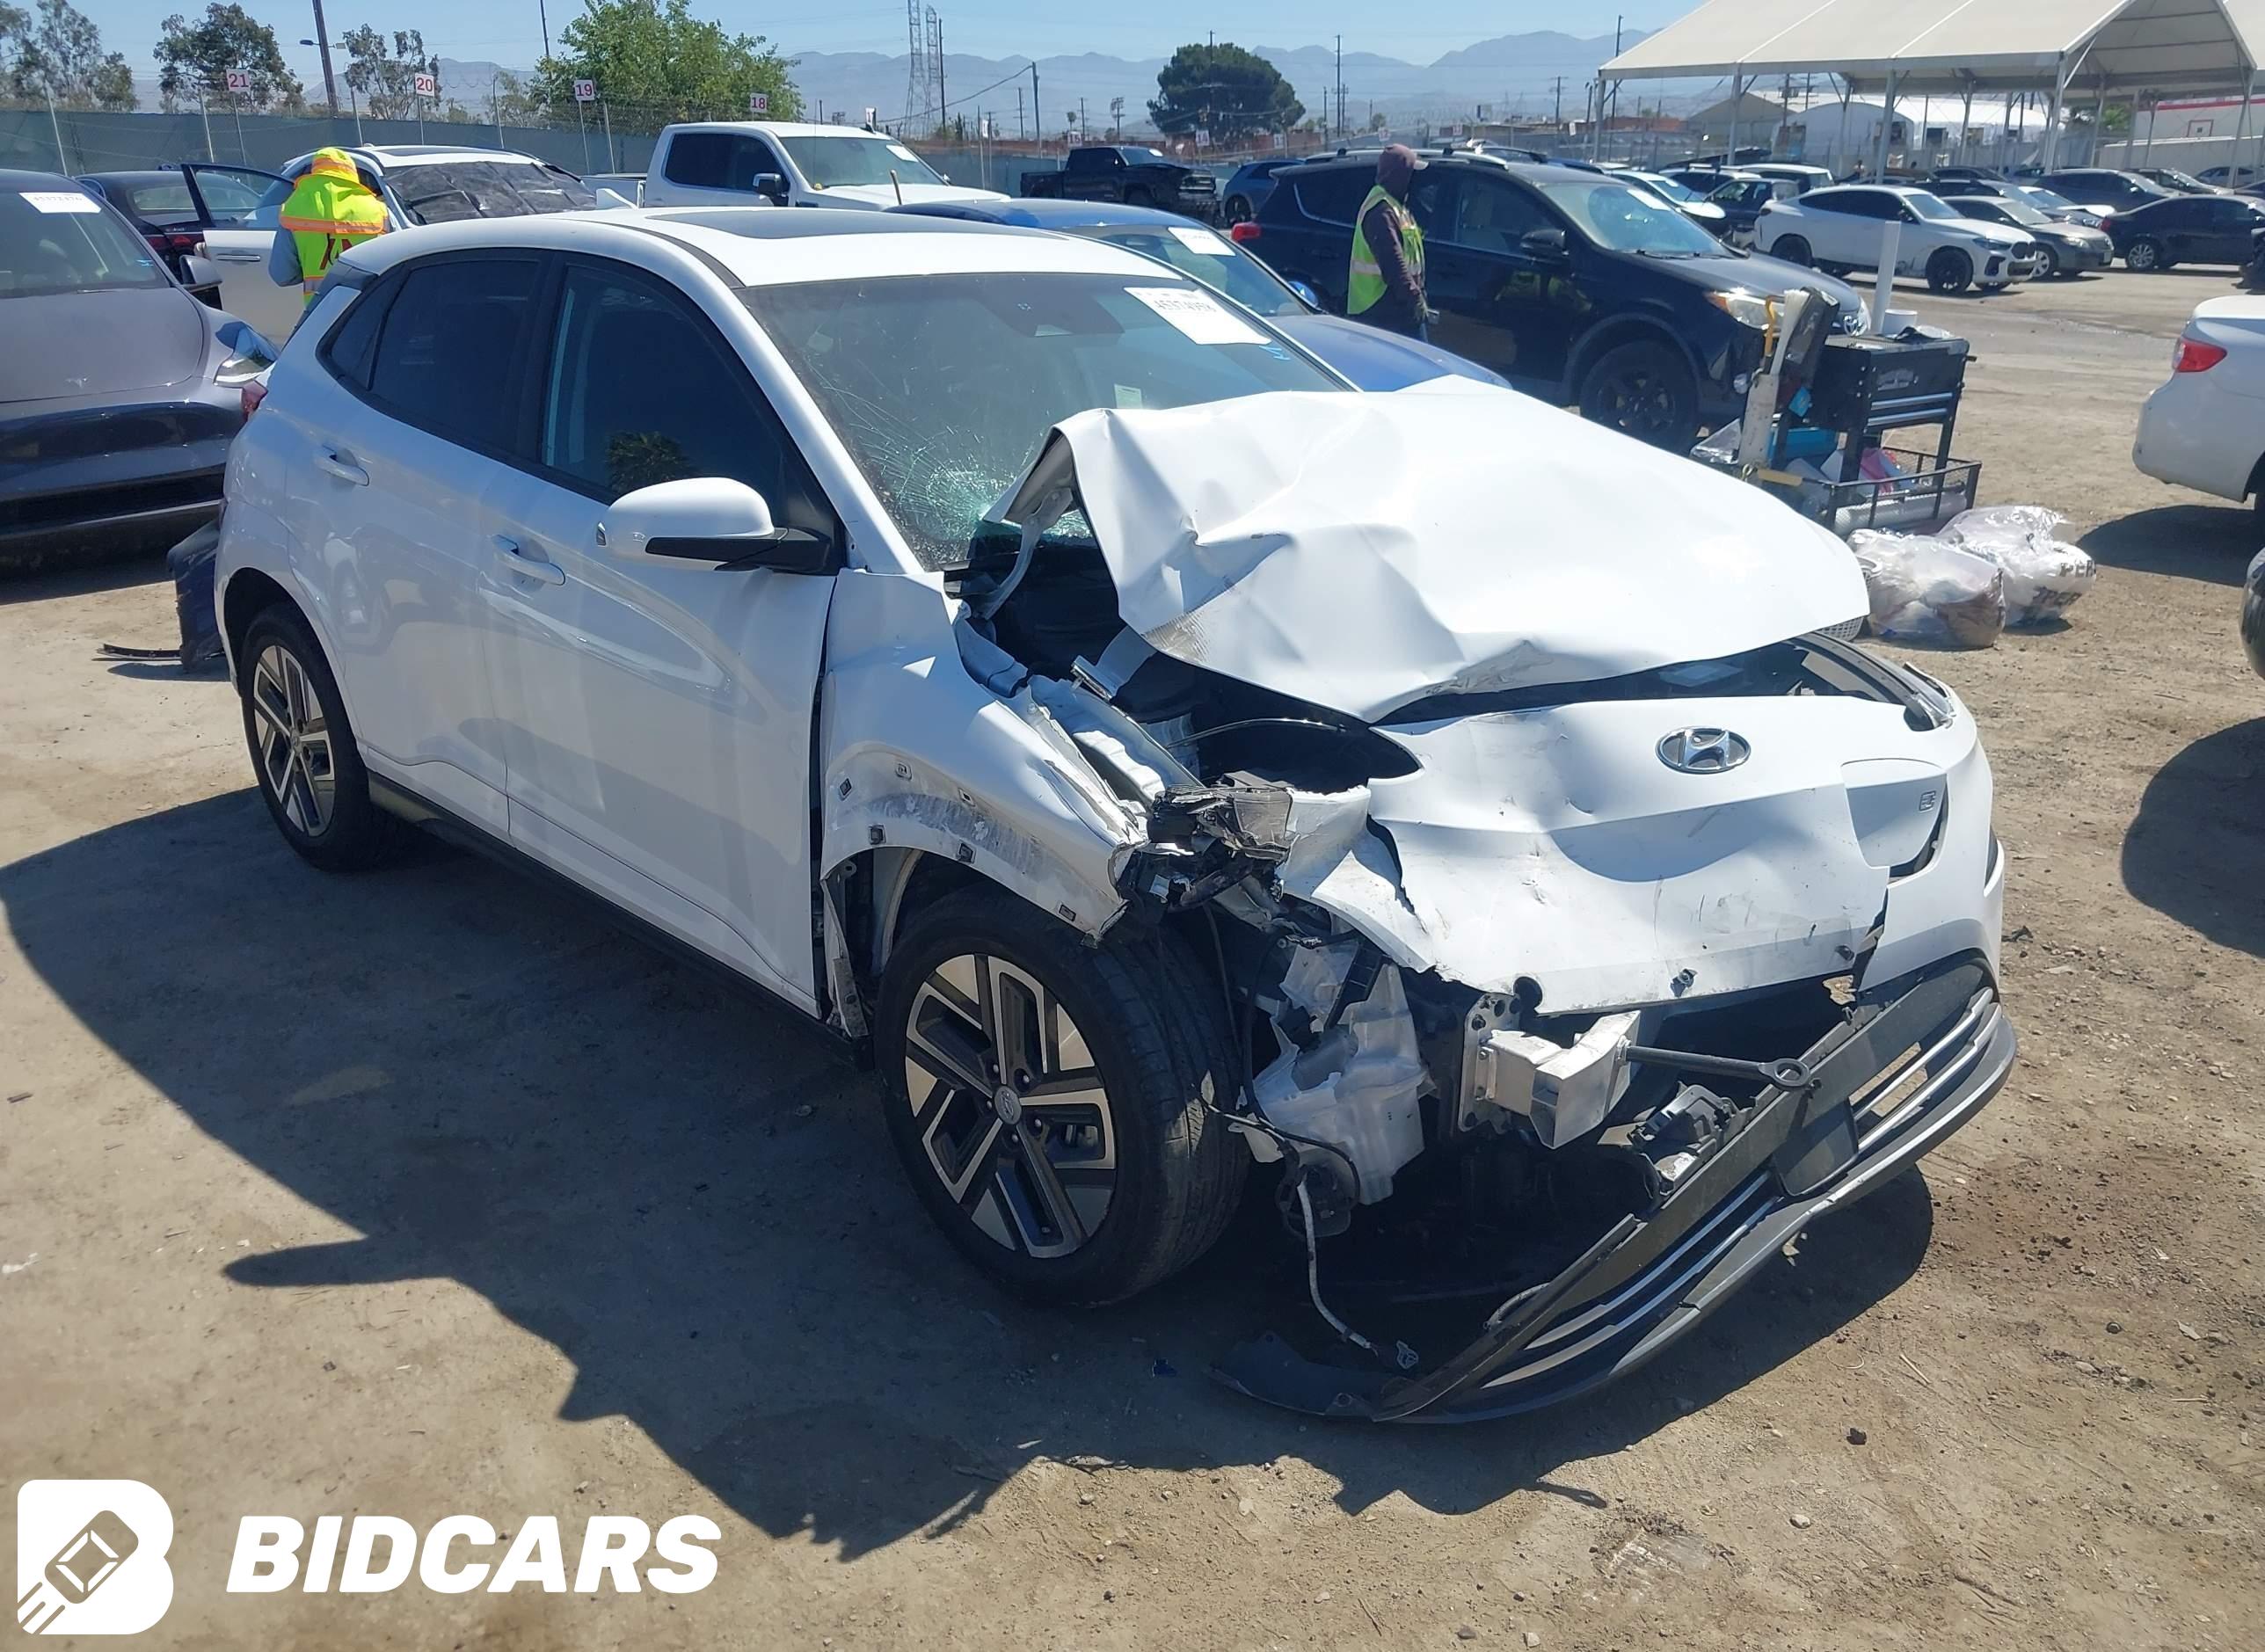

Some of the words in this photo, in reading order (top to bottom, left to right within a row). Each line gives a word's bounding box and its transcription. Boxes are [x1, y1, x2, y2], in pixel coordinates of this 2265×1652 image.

[228, 73, 249, 88] 21
[416, 76, 433, 92] 20
[576, 84, 593, 97] 19
[752, 97, 766, 110] 18
